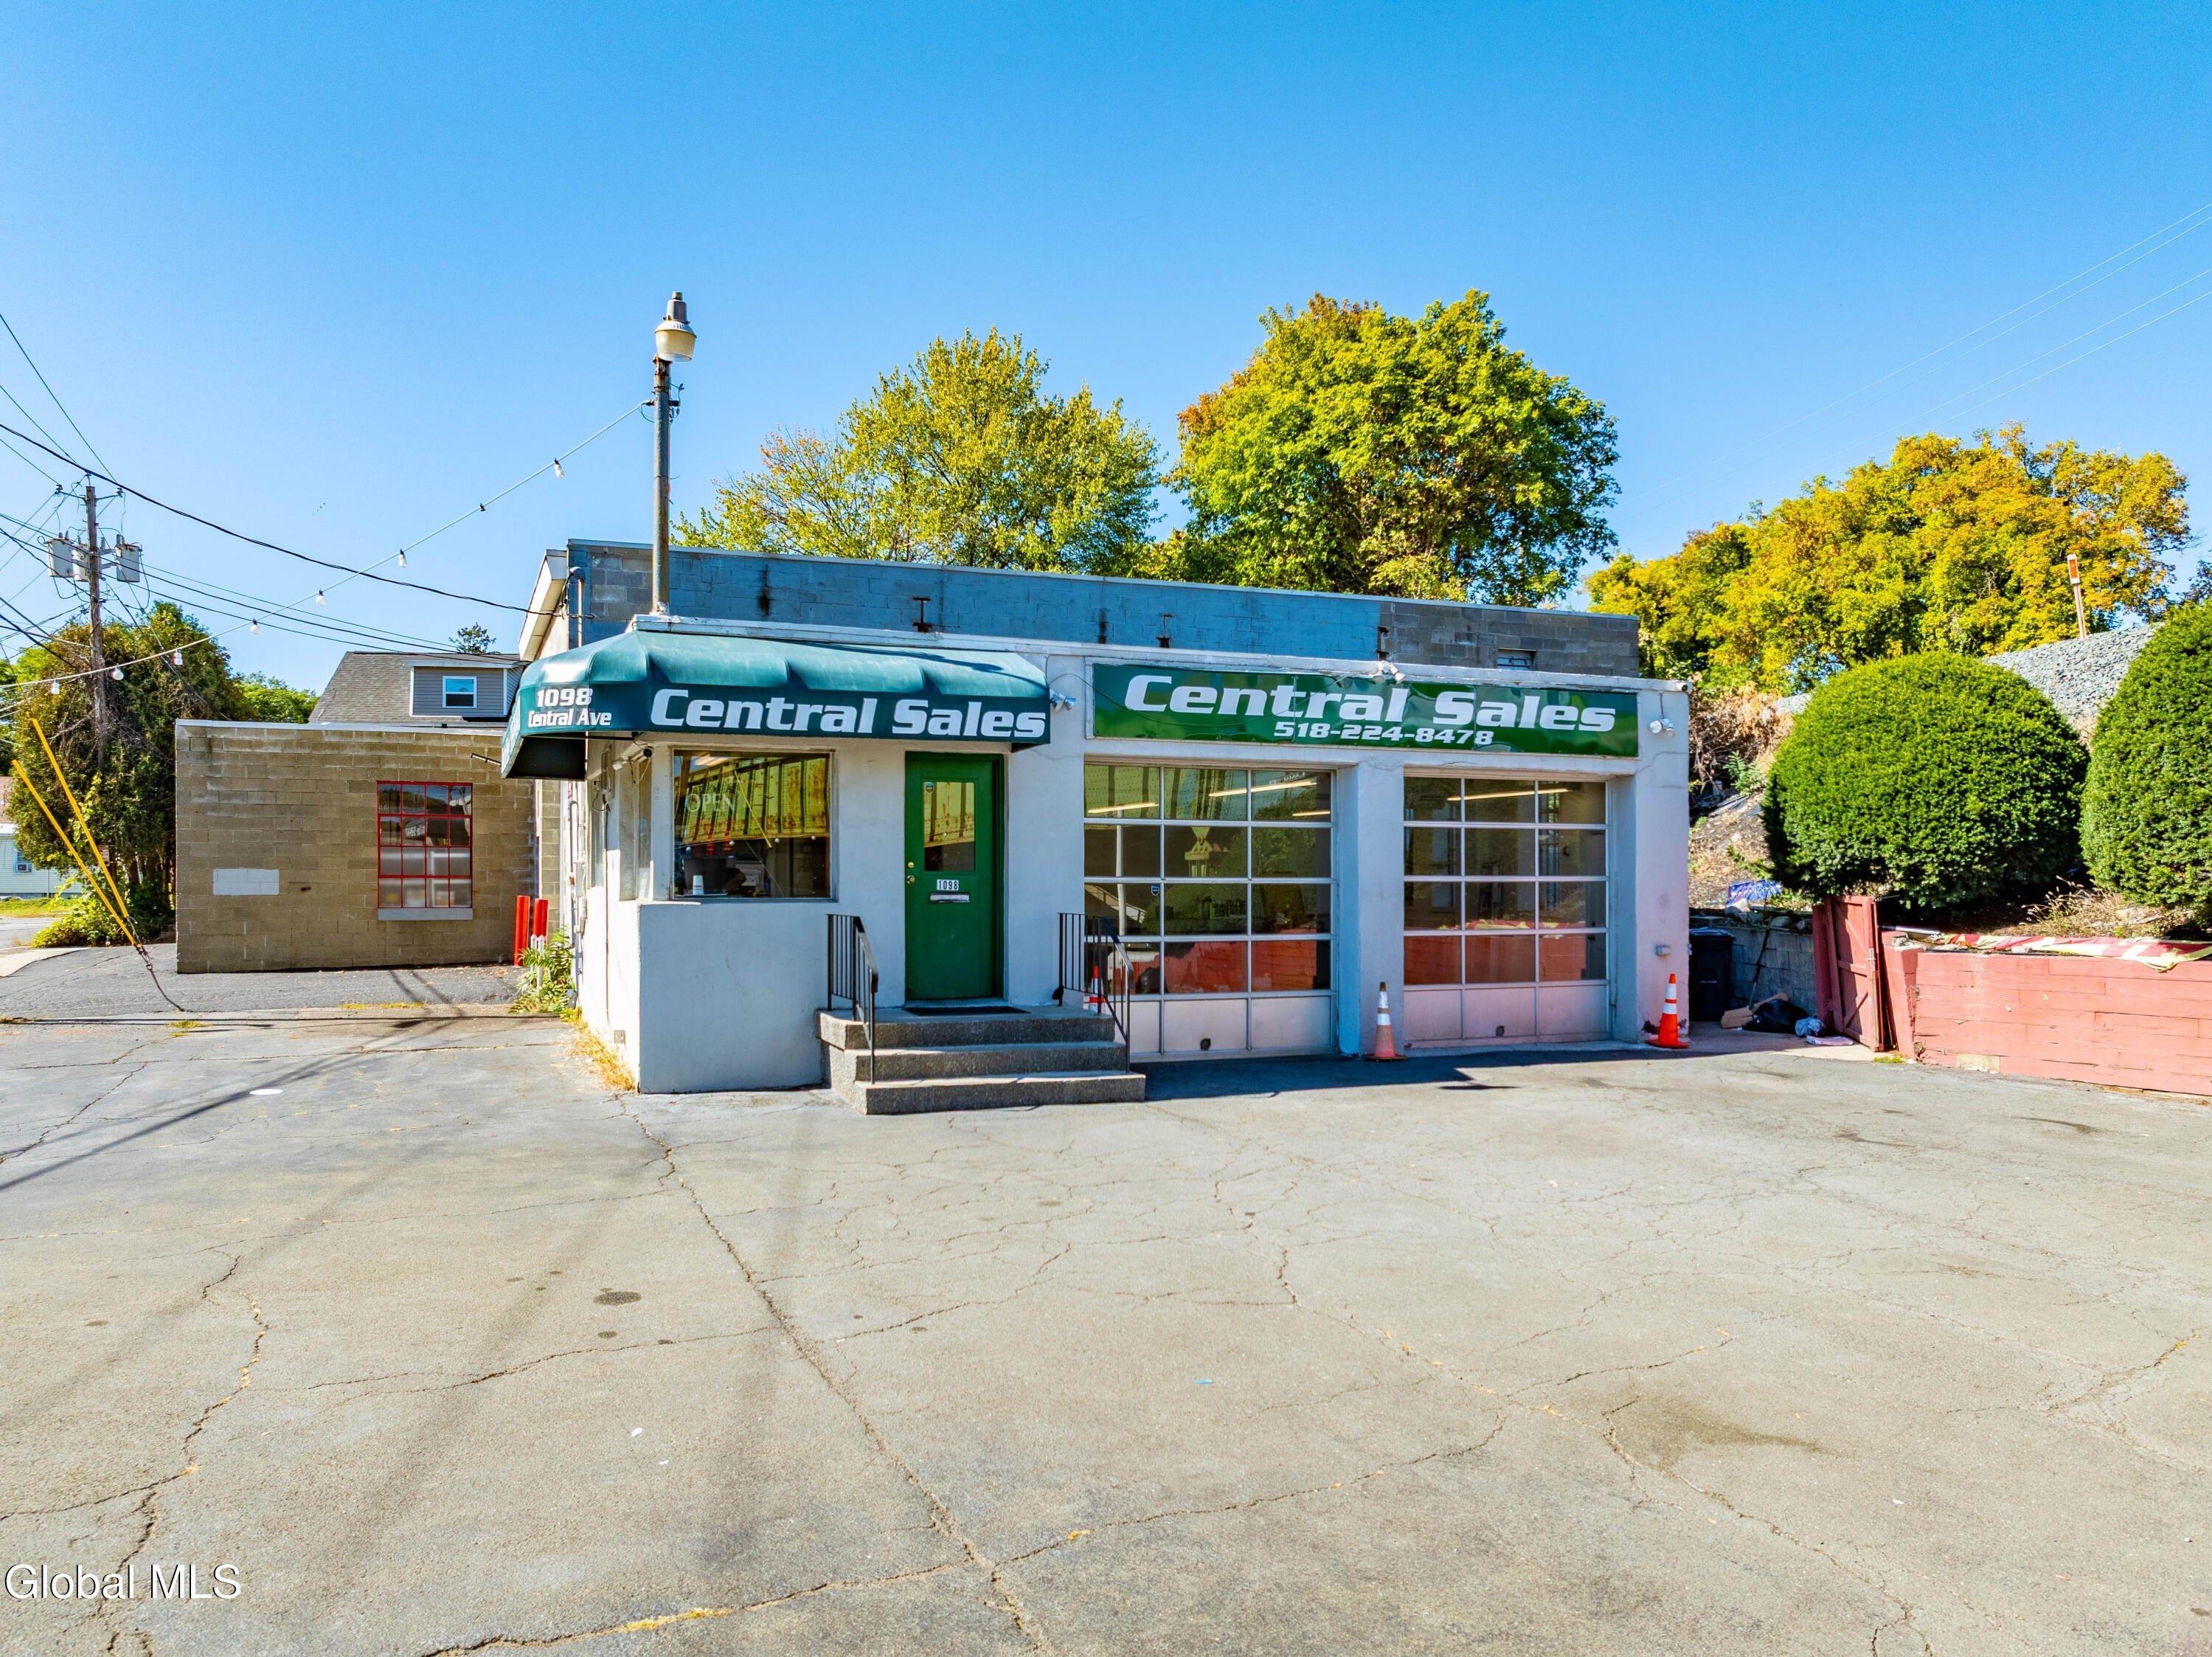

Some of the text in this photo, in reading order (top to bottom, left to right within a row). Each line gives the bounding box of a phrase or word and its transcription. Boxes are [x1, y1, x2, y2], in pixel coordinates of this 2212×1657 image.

[536, 688, 593, 708] 1098
[1124, 674, 1617, 733] Central Sales
[527, 708, 612, 728] Central Ave
[651, 689, 1047, 738] Central Sales
[1273, 721, 1494, 746] 518-224-8478
[684, 793, 735, 812] OPEN
[938, 880, 958, 890] 1098
